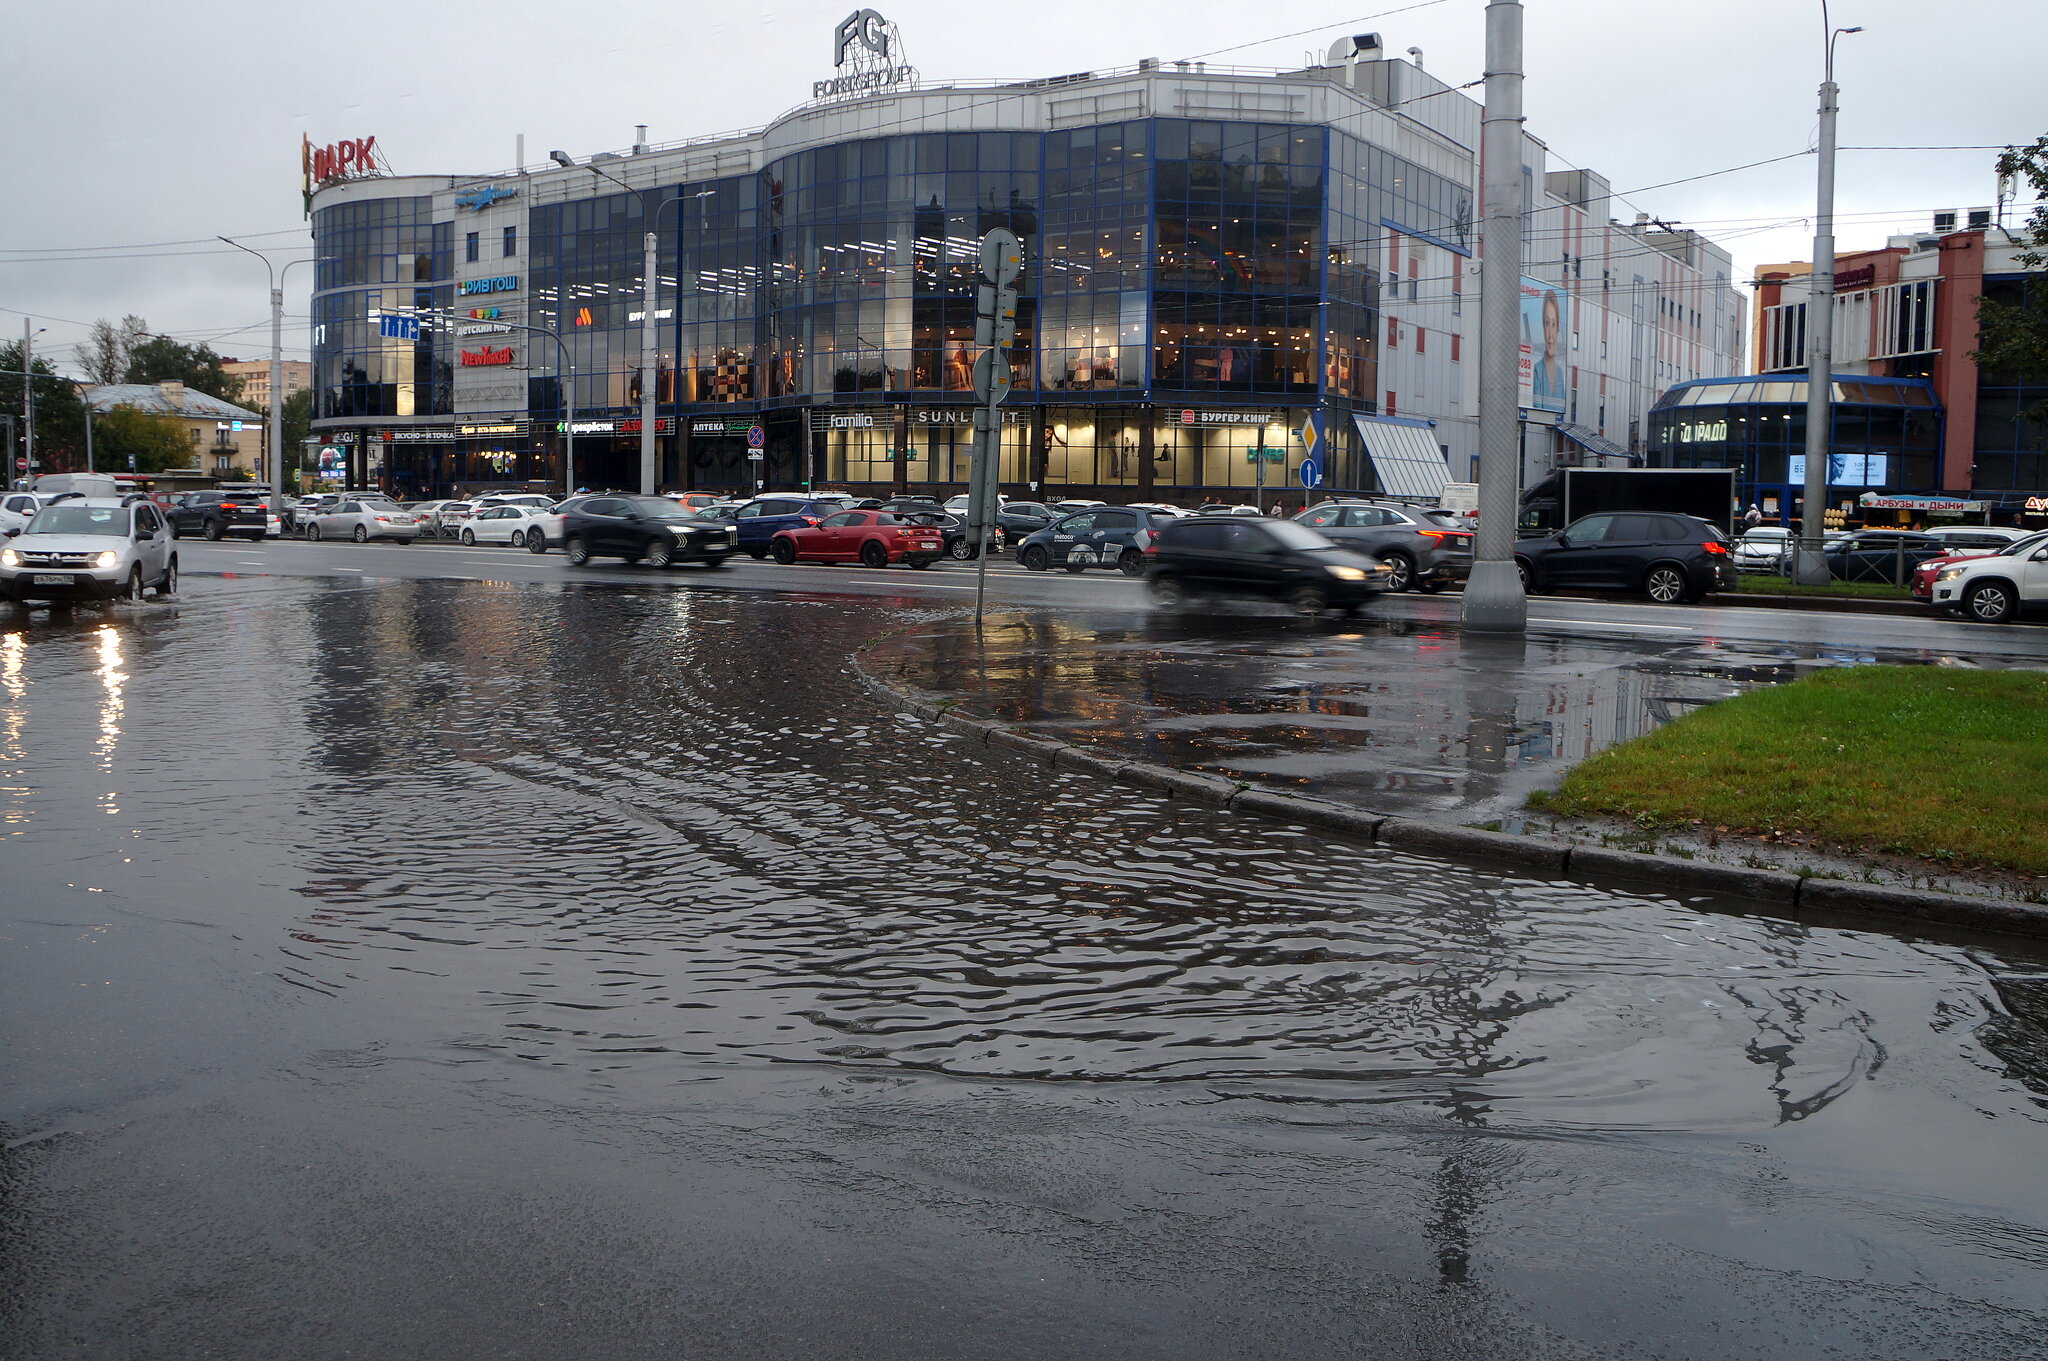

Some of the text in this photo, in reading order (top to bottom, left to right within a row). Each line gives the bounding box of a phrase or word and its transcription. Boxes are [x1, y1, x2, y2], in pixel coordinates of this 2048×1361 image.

[834, 8, 887, 67] FG
[314, 136, 377, 183] ПАРК
[831, 412, 873, 428] familia
[1201, 413, 1241, 423] БУРГЕР
[1243, 414, 1271, 424] КИНГ
[693, 423, 724, 431] АПТЕКА
[1875, 499, 1914, 508] АРБУЗЫ
[1928, 501, 1964, 510] ДЫНИ
